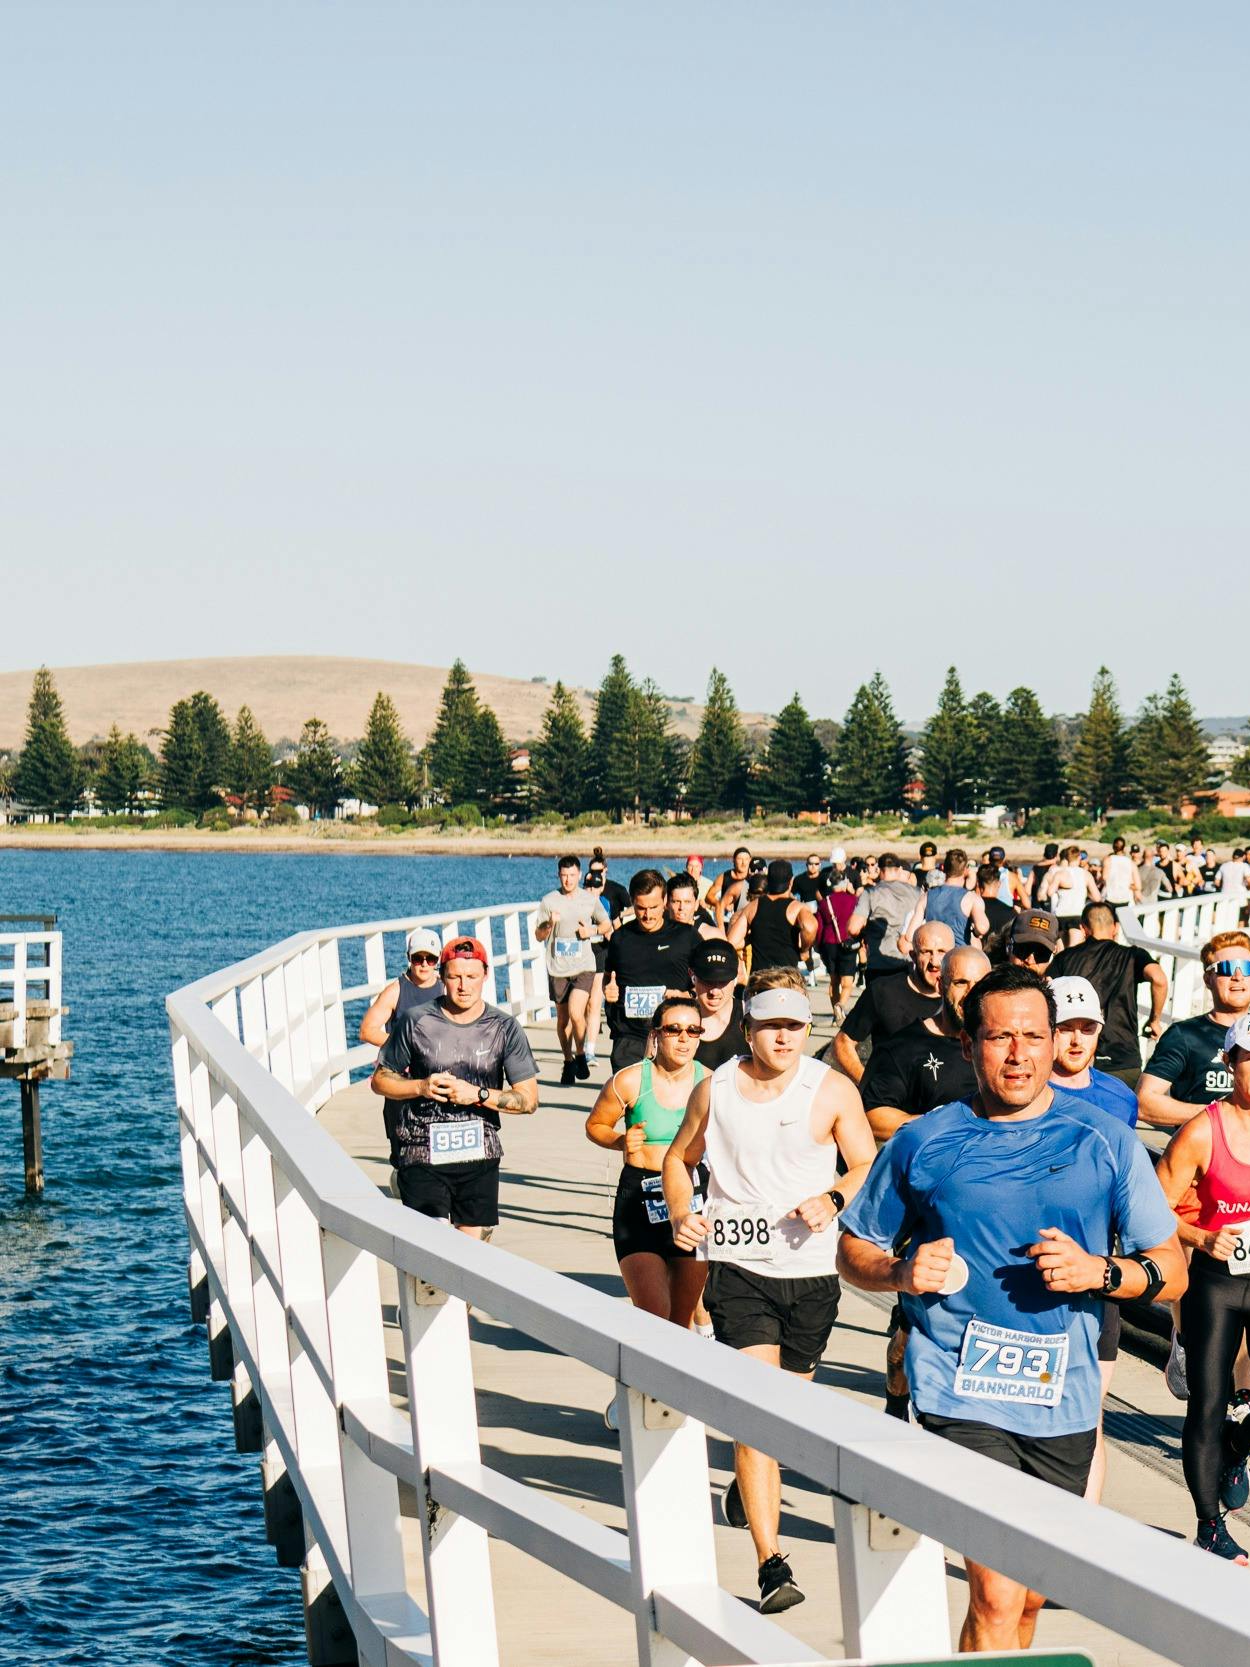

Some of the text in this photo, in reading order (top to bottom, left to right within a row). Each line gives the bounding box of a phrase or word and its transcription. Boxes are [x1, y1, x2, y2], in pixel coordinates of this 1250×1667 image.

[629, 993, 657, 1008] 278
[436, 1129, 476, 1151] 956
[713, 1218, 770, 1246] 8398
[973, 1322, 1004, 1337] VICTOR
[1005, 1331, 1043, 1345] HARBOR
[969, 1338, 1051, 1379] 793
